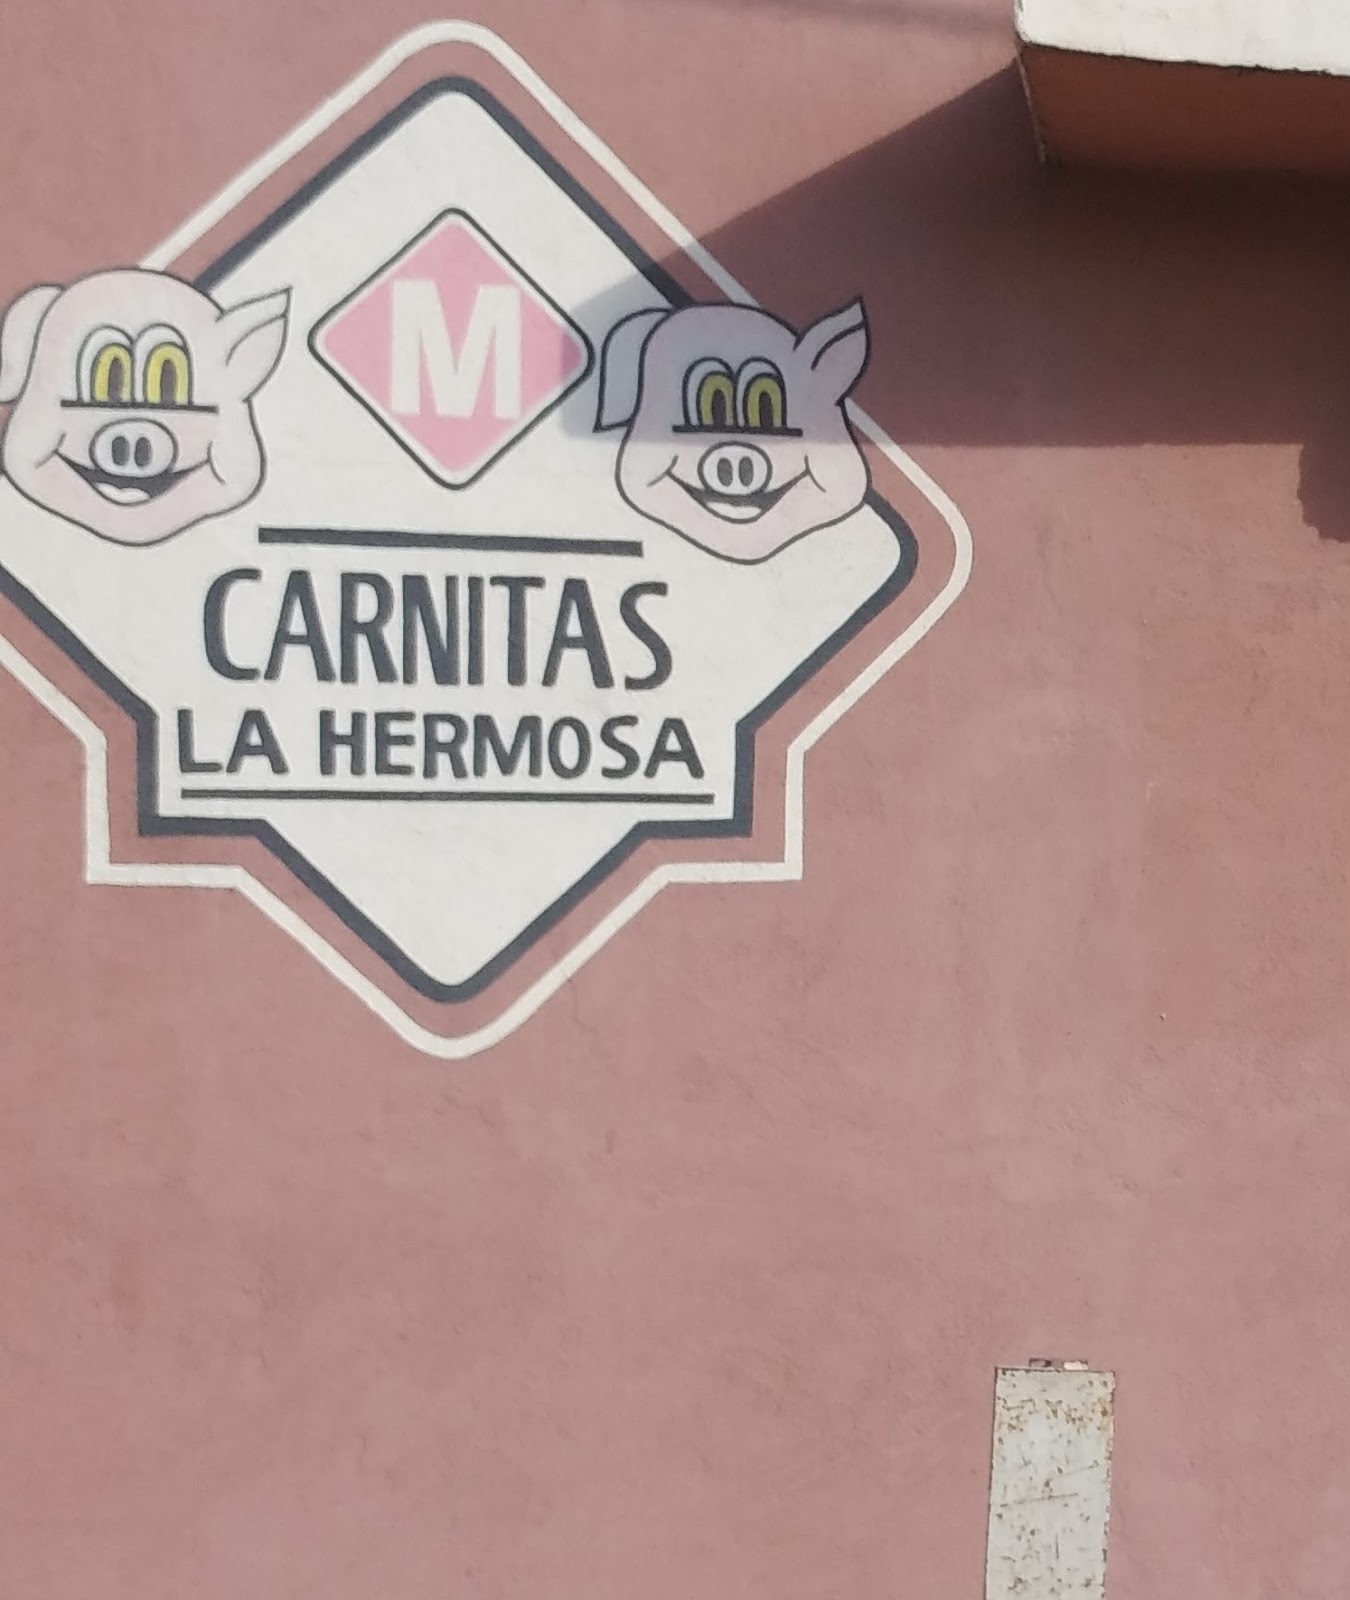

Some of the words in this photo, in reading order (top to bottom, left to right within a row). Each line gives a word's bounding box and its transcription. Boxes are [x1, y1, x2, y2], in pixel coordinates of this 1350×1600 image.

[389, 278, 522, 421] M
[202, 568, 674, 690] CARNITAS
[177, 708, 288, 776] LA
[319, 709, 705, 780] HERMOSA
